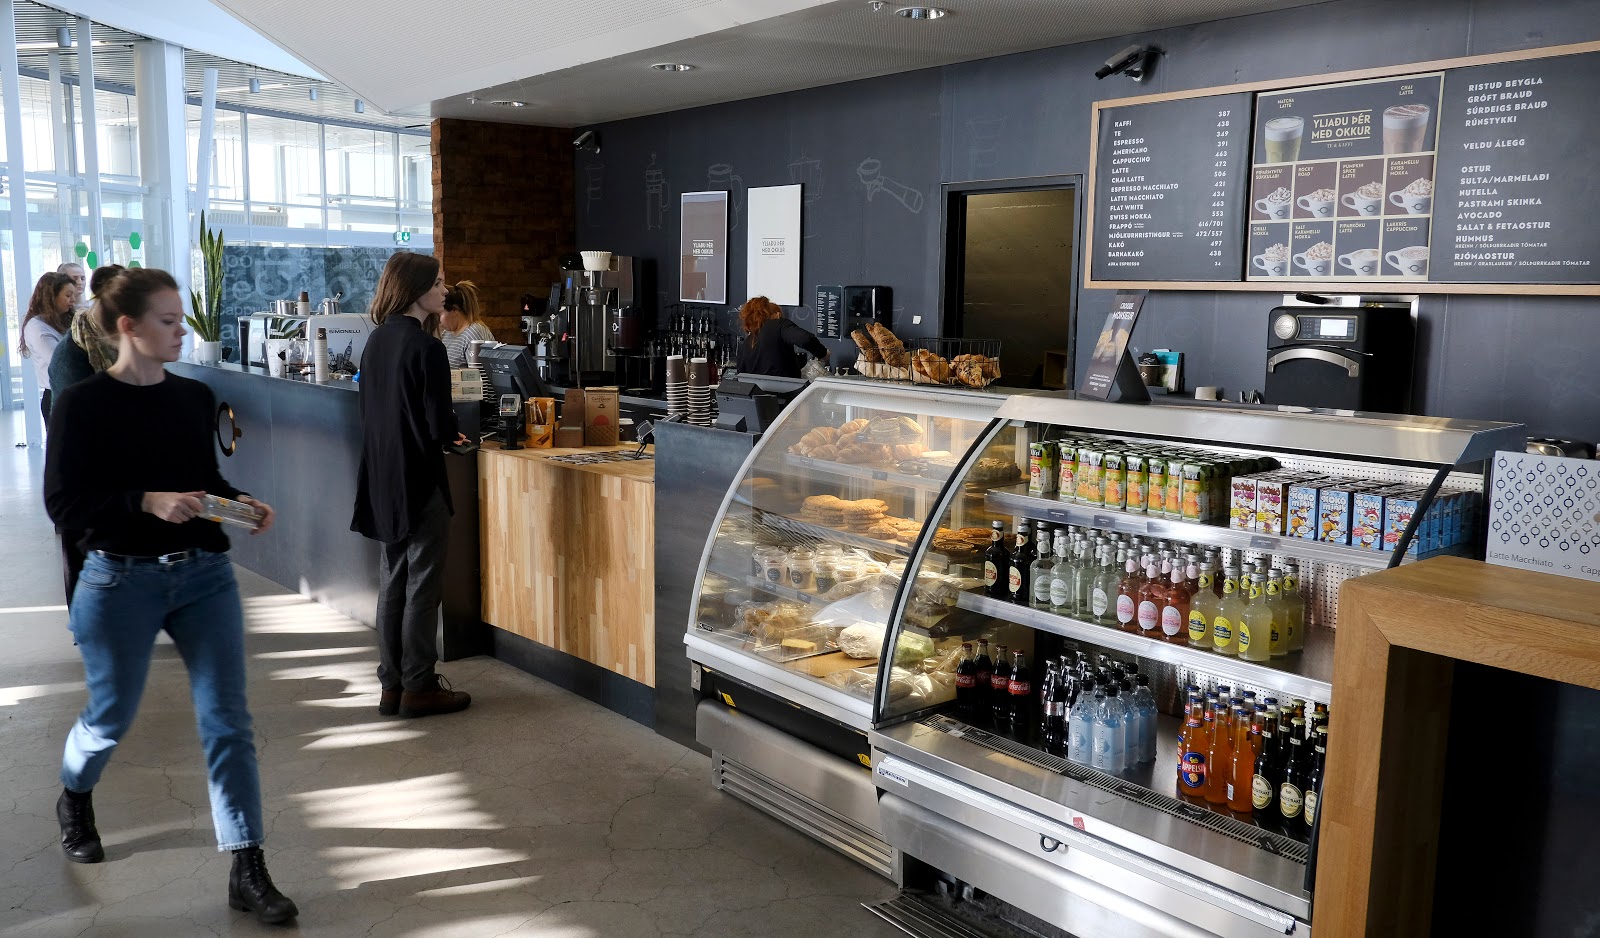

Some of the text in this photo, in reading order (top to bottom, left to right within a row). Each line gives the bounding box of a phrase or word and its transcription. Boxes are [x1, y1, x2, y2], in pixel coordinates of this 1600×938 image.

[1505, 77, 1543, 88] BEYGLA
[1467, 90, 1532, 103] GRÓFT BRAUÐ
[1466, 101, 1547, 115] SÚRDEIGS BRAUÐ
[1313, 113, 1370, 129] YLJAÐU ÞÉR
[1465, 116, 1517, 127] RÚNSTYKKI
[1312, 126, 1370, 139] MEÐ OKKUR
[1114, 138, 1144, 146] ESPRESSO
[1463, 139, 1525, 150] VELDU ÁLEGG
[1113, 147, 1148, 155] AMERICANO
[1112, 156, 1150, 164] CAPPUCCINO
[1461, 165, 1491, 173] OSTUR
[1460, 173, 1550, 185] SULTA/MARMELAÐI
[1111, 185, 1141, 193] ESPRESSO
[1143, 183, 1179, 191] MACCHIATO
[1459, 188, 1498, 196] NUTELLA
[1458, 198, 1542, 208] PASTRAMI SKINKA
[1457, 211, 1503, 220] AVOCADO
[1109, 222, 1132, 230] FRAPPÓ
[1456, 223, 1485, 231] SALAT
[1496, 221, 1551, 230] FETAOSTUR
[1456, 235, 1494, 243] HUMMUS
[1454, 252, 1515, 260] RJÓMAOSTUR
[1489, 551, 1600, 577] Latte Macchiato Capp
